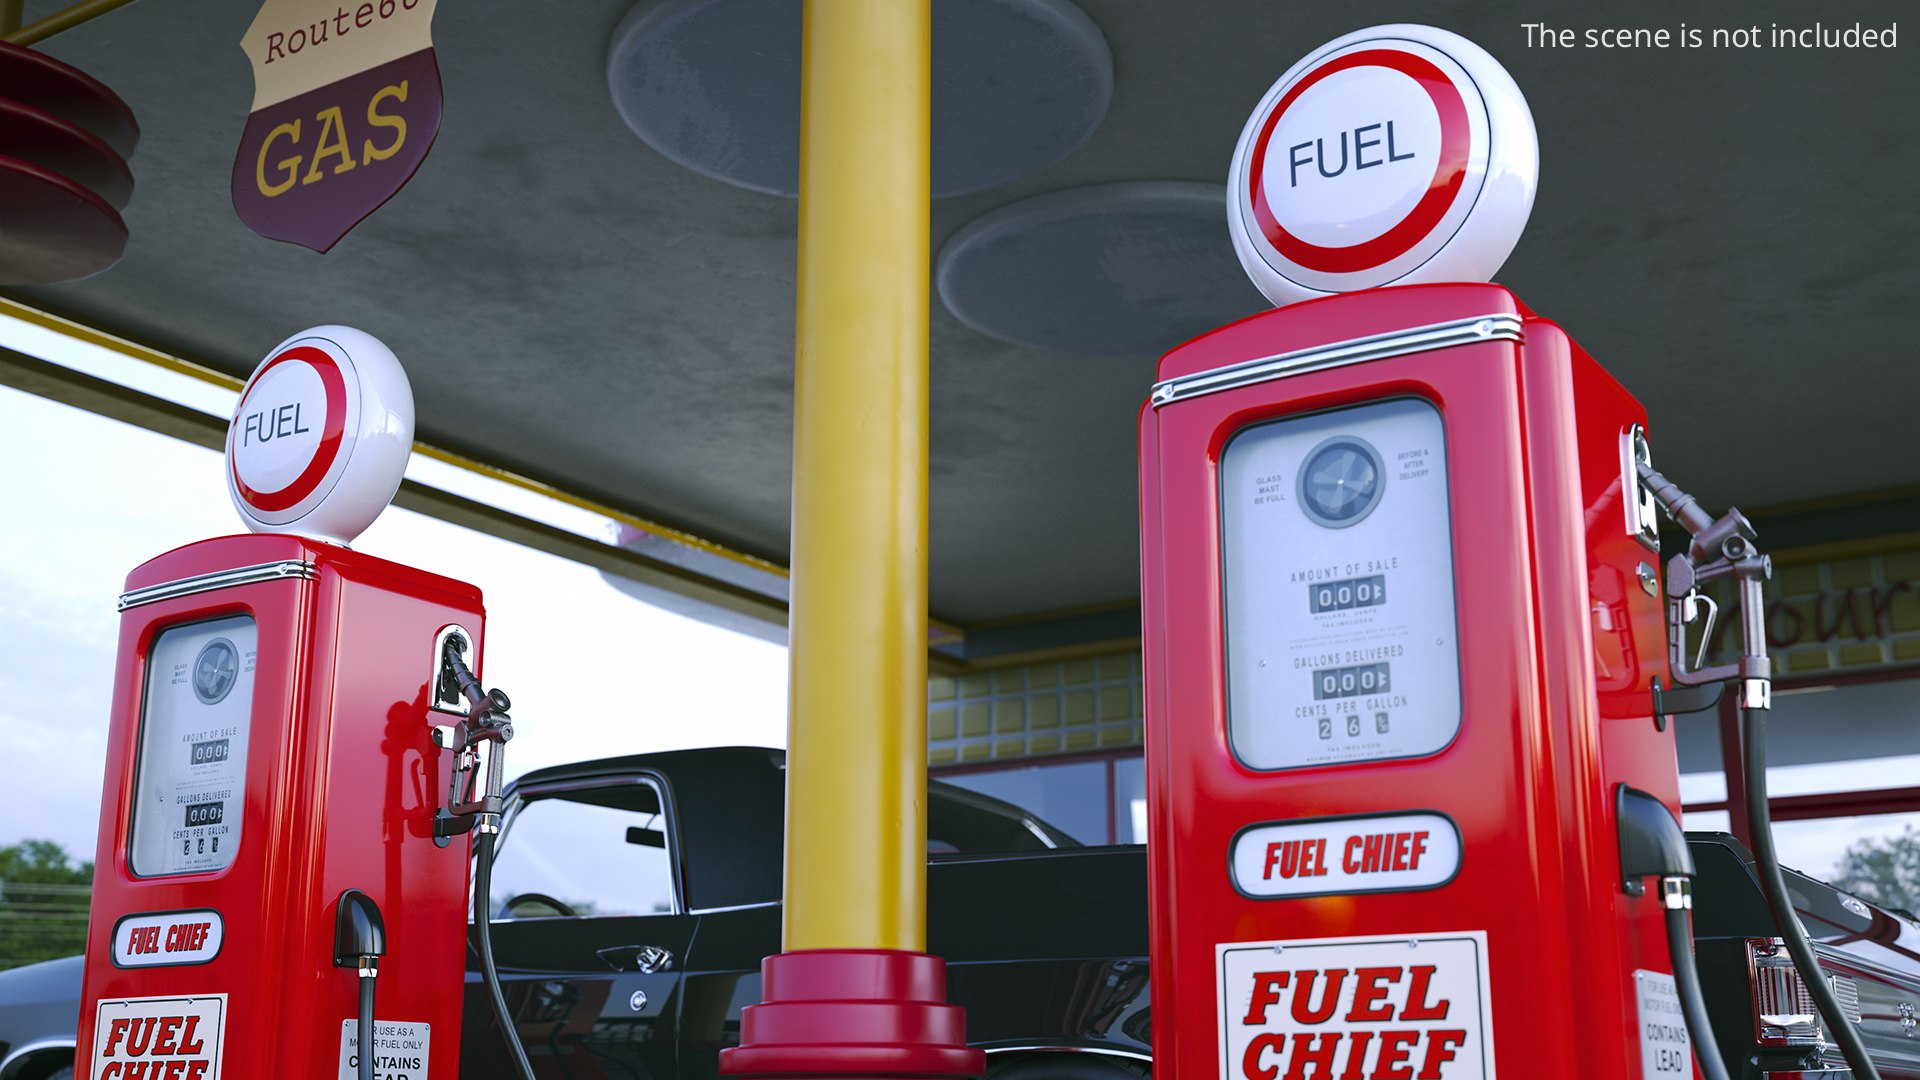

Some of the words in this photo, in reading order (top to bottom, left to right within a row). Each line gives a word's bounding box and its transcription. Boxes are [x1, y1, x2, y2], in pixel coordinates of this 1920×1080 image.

[256, 80, 408, 198] GAS
[1290, 120, 1415, 188] FUEL
[244, 402, 309, 447] FUEL
[1397, 450, 1423, 461] BEFORE
[1403, 460, 1424, 470] AFTER
[1256, 475, 1282, 485] GLASS
[1399, 469, 1429, 480] DELIVERY
[1254, 497, 1265, 505] BE
[1266, 494, 1286, 504] FULL
[1259, 485, 1280, 495] MAST
[1291, 566, 1338, 583] AMOUNT
[1345, 563, 1360, 576] OF
[1367, 557, 1399, 572] SALE
[1294, 653, 1340, 669] GALLONS
[1345, 644, 1404, 663] DELIVERED
[1295, 704, 1327, 718] CENTS
[1336, 701, 1357, 714] PER
[1366, 695, 1408, 711] GALLON
[183, 731, 207, 742] AMOUNT
[210, 729, 218, 739] OF
[221, 726, 237, 737] SALE
[176, 793, 200, 804] GALLONS
[202, 789, 232, 801] DELIVERED
[173, 829, 190, 839] CENTS
[193, 828, 204, 837] PER
[207, 825, 229, 836] GALLON
[1263, 838, 1328, 880] FUEL
[1342, 831, 1429, 875] CHIEF
[127, 926, 161, 955] FUEL
[165, 922, 211, 953] CHIEF
[1243, 965, 1450, 1026] FUEL
[103, 1015, 204, 1057] FUEL
[379, 1026, 396, 1036] USE
[397, 1027, 408, 1037] AS
[408, 1028, 415, 1037] A
[1646, 1023, 1687, 1044] CONTAINS
[381, 1039, 401, 1049] FUEL
[402, 1040, 423, 1050] ONLY
[1243, 1029, 1467, 1080] CHIEF
[349, 1055, 421, 1070] CNTAINS
[1655, 1049, 1683, 1073] LEAD
